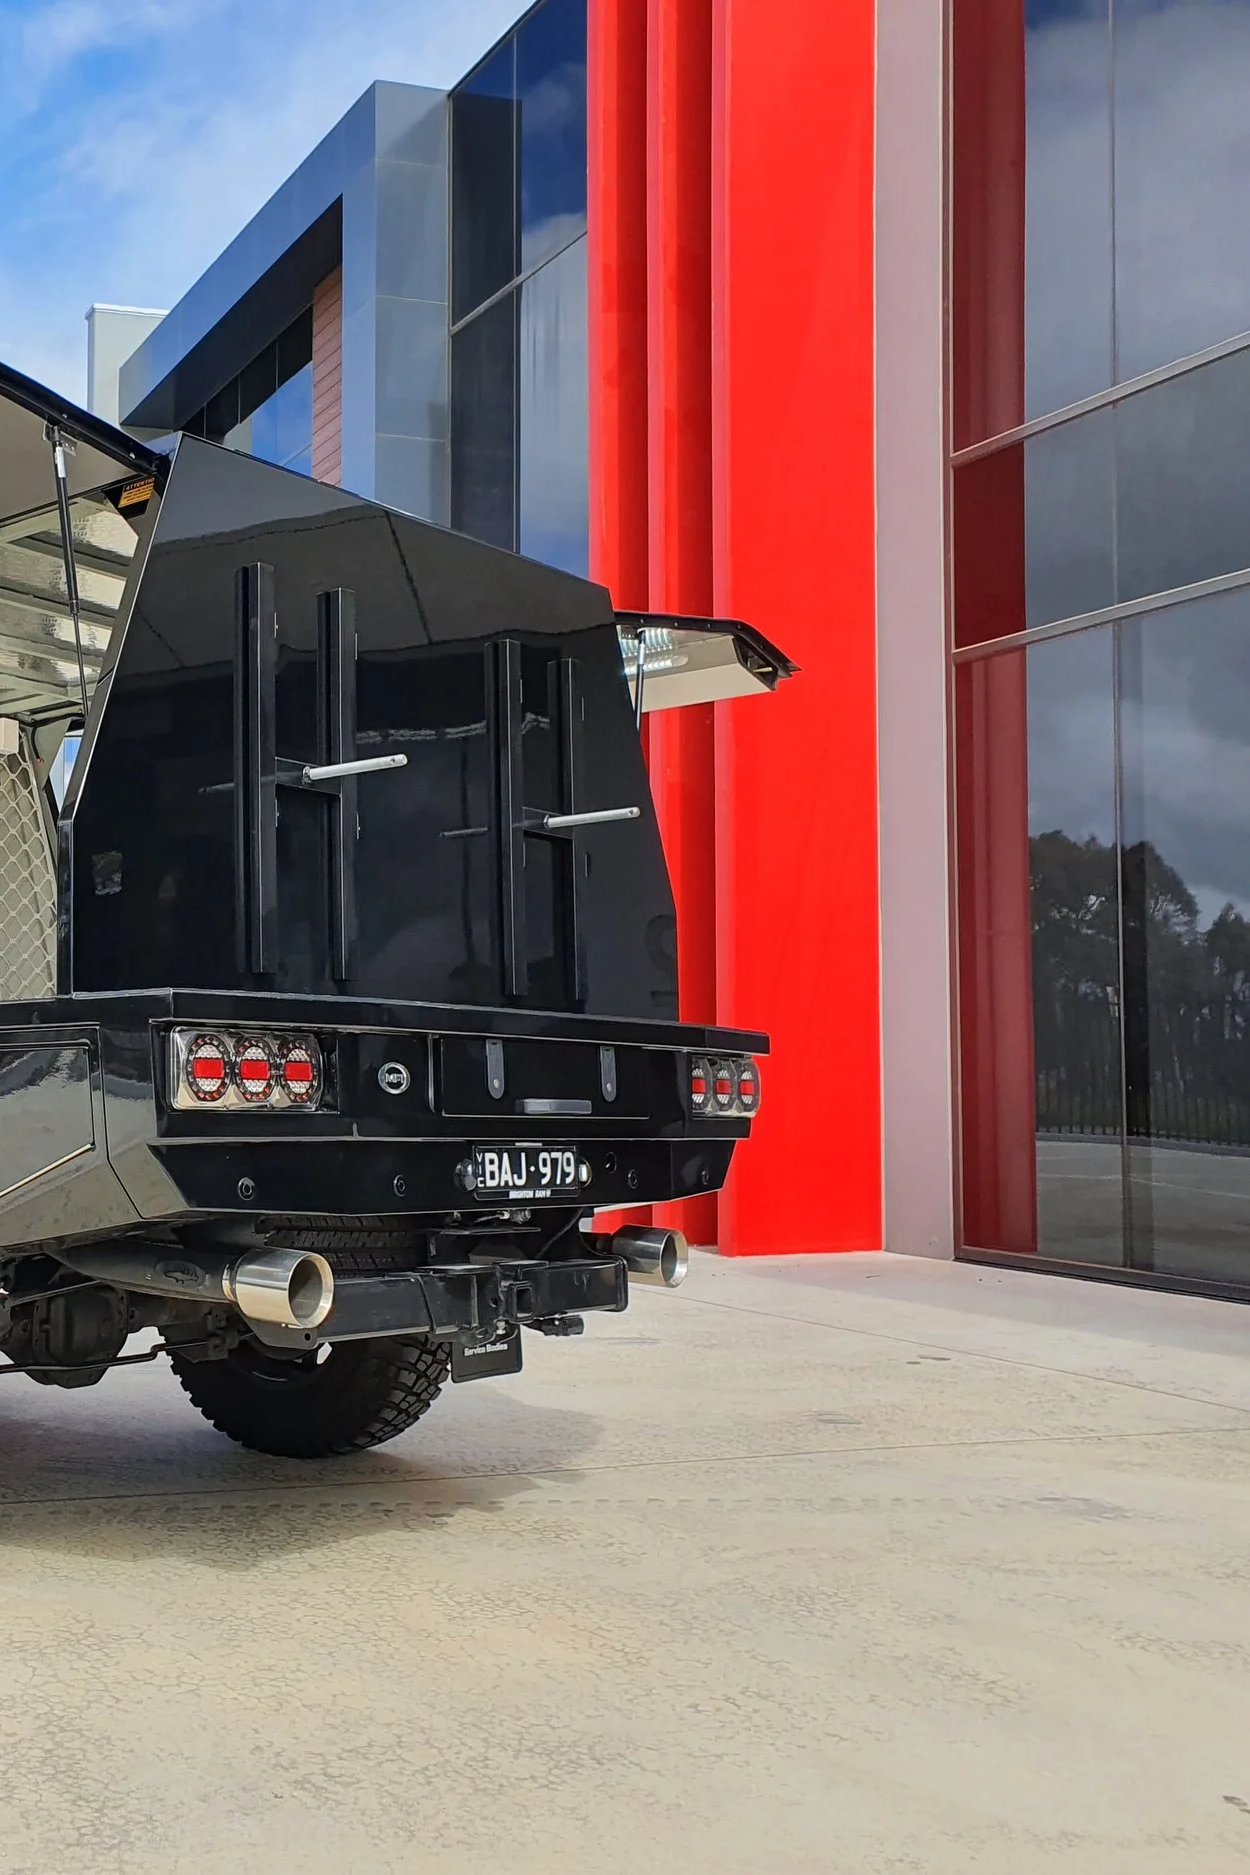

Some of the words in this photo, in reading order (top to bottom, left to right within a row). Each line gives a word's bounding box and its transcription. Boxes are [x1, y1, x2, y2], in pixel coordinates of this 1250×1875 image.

[125, 477, 155, 491] ATTENTIO
[464, 1345, 486, 1356] Service
[486, 1343, 508, 1353] Bodies
